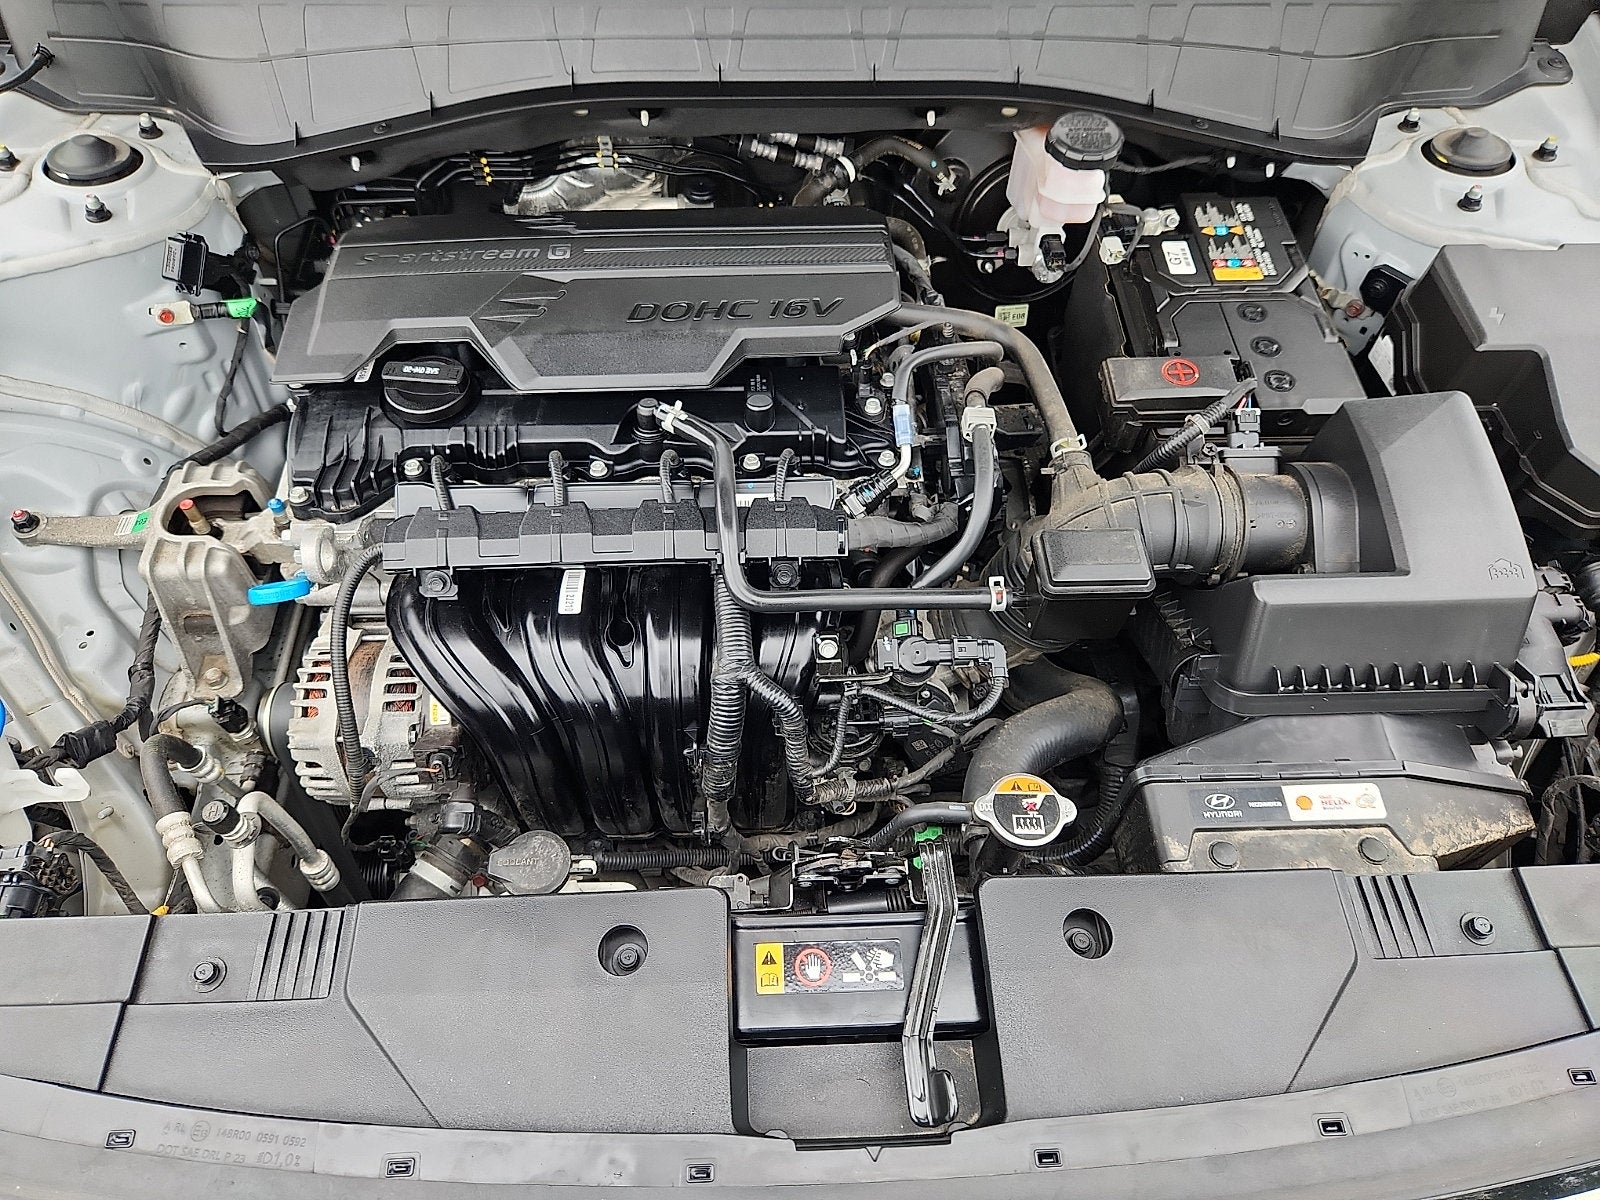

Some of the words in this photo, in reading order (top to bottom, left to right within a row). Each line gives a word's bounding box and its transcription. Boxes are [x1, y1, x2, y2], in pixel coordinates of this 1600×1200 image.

[626, 299, 759, 323] DOHC
[768, 297, 845, 319] 16V
[1203, 810, 1243, 818] HYUNDAI
[497, 857, 539, 867] COOLANT
[256, 1132, 280, 1145] 0591
[282, 1135, 307, 1148] 0592
[156, 1143, 180, 1155] DOT
